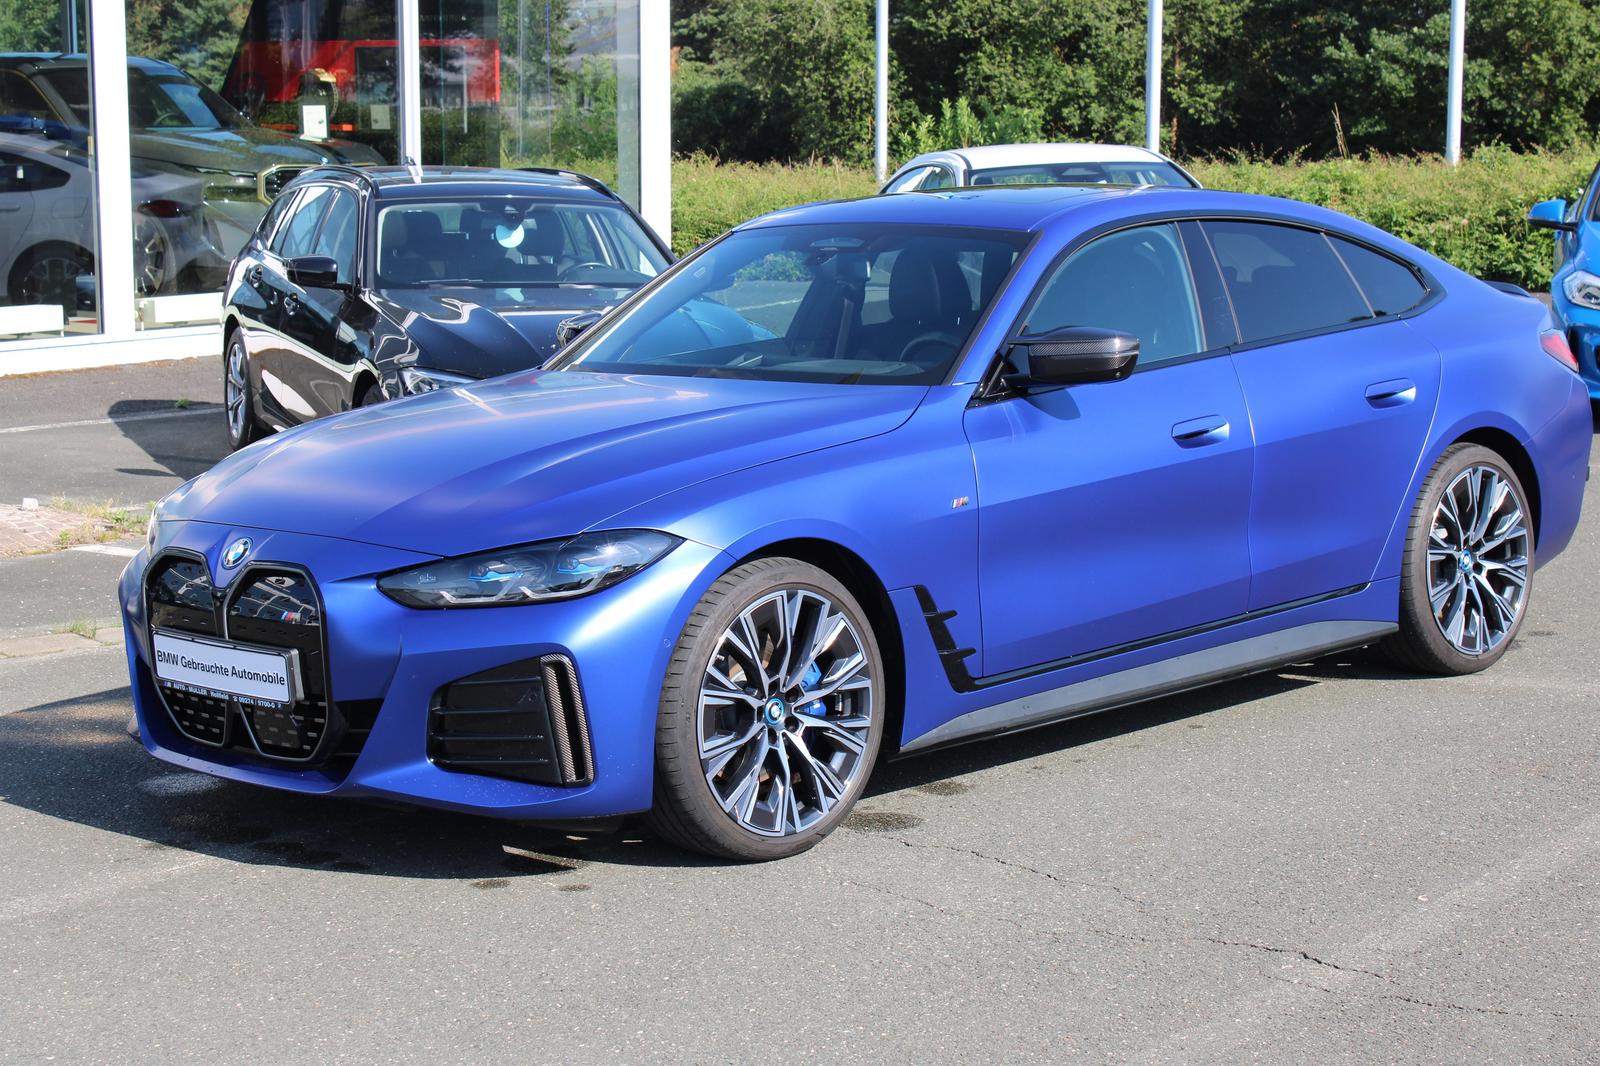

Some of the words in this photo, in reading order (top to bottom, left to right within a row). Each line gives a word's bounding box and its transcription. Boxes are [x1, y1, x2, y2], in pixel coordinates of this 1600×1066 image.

[157, 650, 179, 666] BMW
[180, 656, 229, 676] Gebrauchte
[231, 666, 285, 685] Automobile
